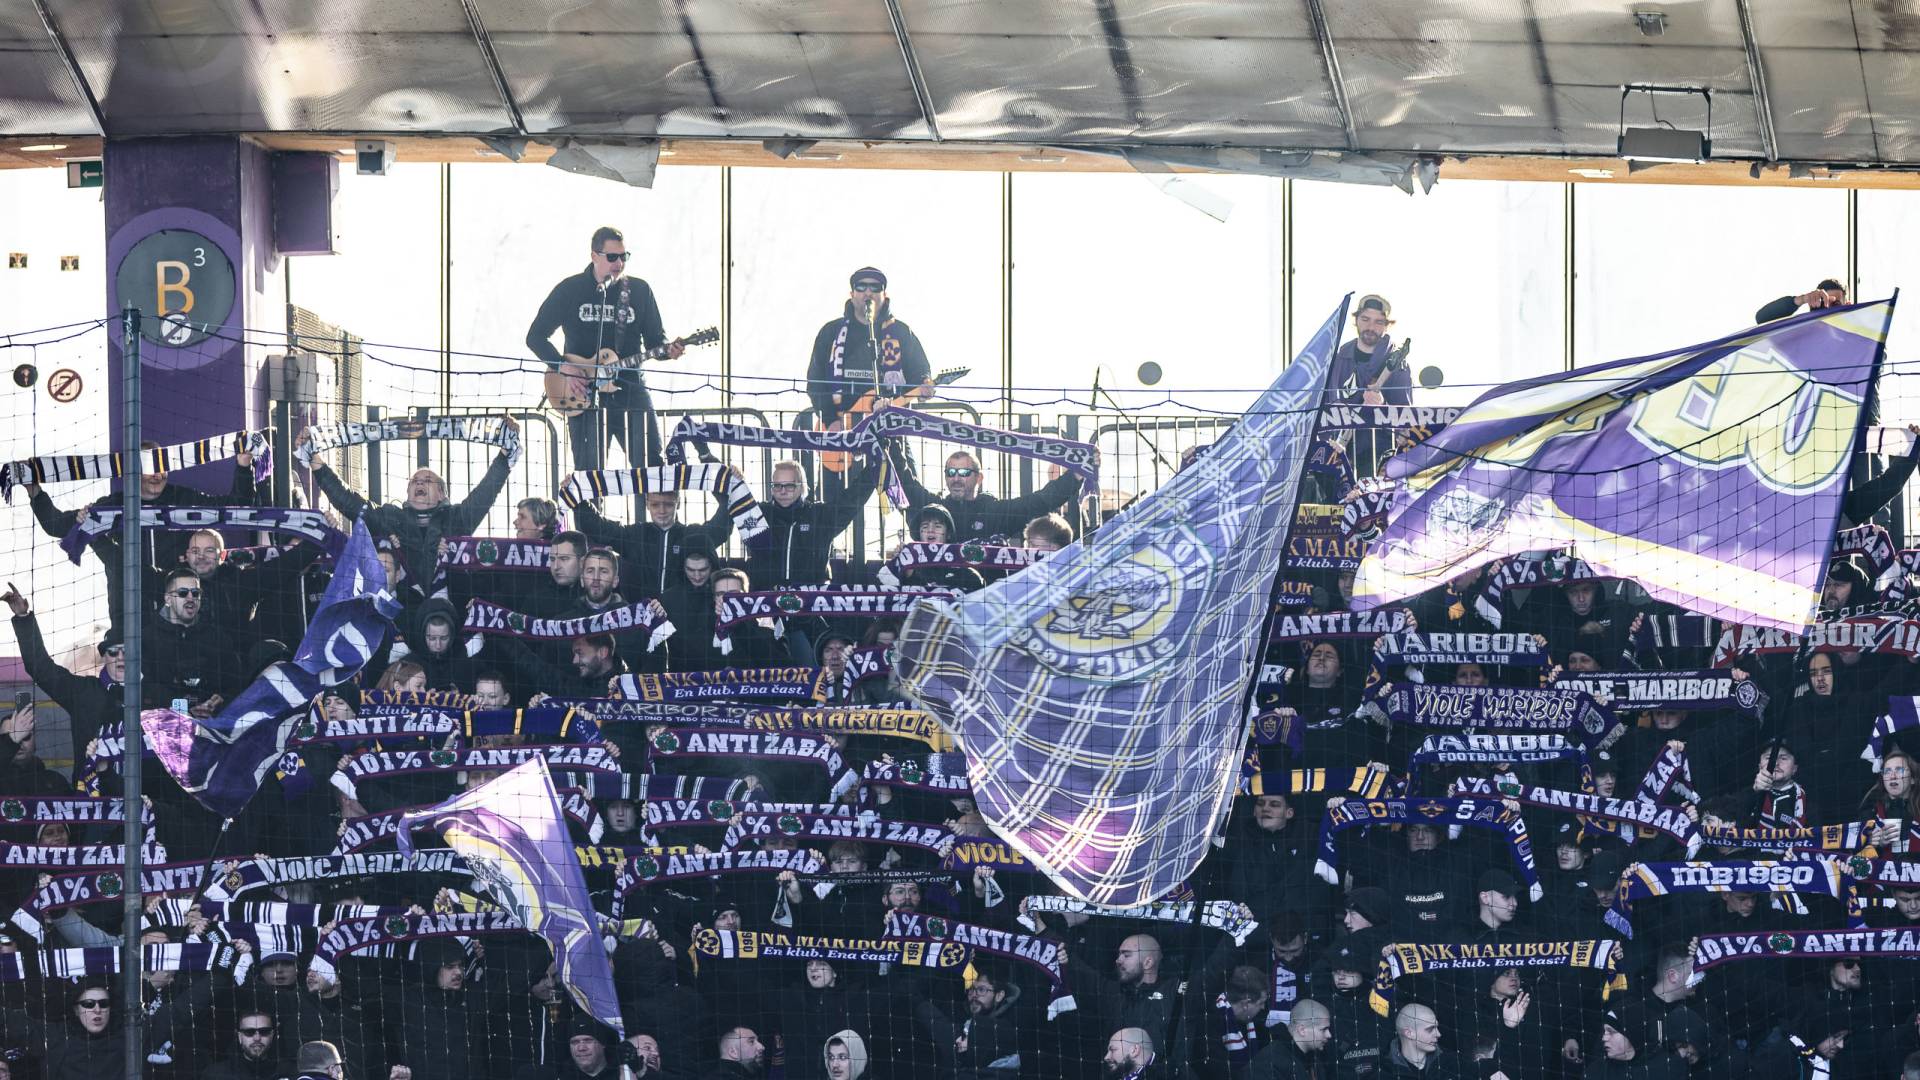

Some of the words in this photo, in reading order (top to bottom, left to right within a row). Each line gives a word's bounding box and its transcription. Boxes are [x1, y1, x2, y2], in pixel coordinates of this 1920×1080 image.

[155, 260, 195, 317] B
[194, 247, 206, 267] 3
[847, 370, 875, 378] maribo
[1320, 406, 1365, 427] NK
[811, 596, 886, 612] ANTI
[531, 617, 585, 637] ANTI
[1280, 612, 1350, 637] ANTI
[1404, 654, 1472, 664] FOOTBALL
[1475, 654, 1510, 664] CLUB
[663, 671, 699, 688] NK
[674, 687, 694, 698] En
[697, 684, 735, 697] klub.
[739, 683, 768, 696] Ena
[772, 681, 806, 696] čast.
[1628, 679, 1733, 701] MARIBOR
[596, 702, 721, 718] MARIBOR
[1414, 691, 1476, 718] VIOLE
[1482, 694, 1577, 721] MARIBOR
[325, 715, 396, 737] ANTI
[754, 711, 793, 731] NK
[802, 711, 940, 738] MARIBOR
[686, 732, 759, 754] ANTI
[350, 751, 423, 777] 101%
[1438, 751, 1518, 763] FOOTBALL
[1521, 750, 1561, 762] CLUB
[1530, 786, 1601, 813] ANTI
[36, 800, 104, 821] ANTI
[810, 817, 883, 840] ANTI
[6, 844, 77, 865] ANTI
[666, 850, 733, 876] ANTI
[417, 912, 486, 934] ANTI
[953, 923, 1012, 952] ANTI
[1803, 931, 1875, 953] ANTI
[763, 946, 783, 957] En
[786, 946, 823, 960] klub.
[828, 950, 859, 962] Ena
[861, 950, 900, 963] čast!
[1419, 943, 1454, 961] NK
[1429, 959, 1449, 970] En
[1452, 957, 1491, 970] klub.
[1495, 956, 1524, 967] Ena
[1528, 955, 1568, 967] čast!
